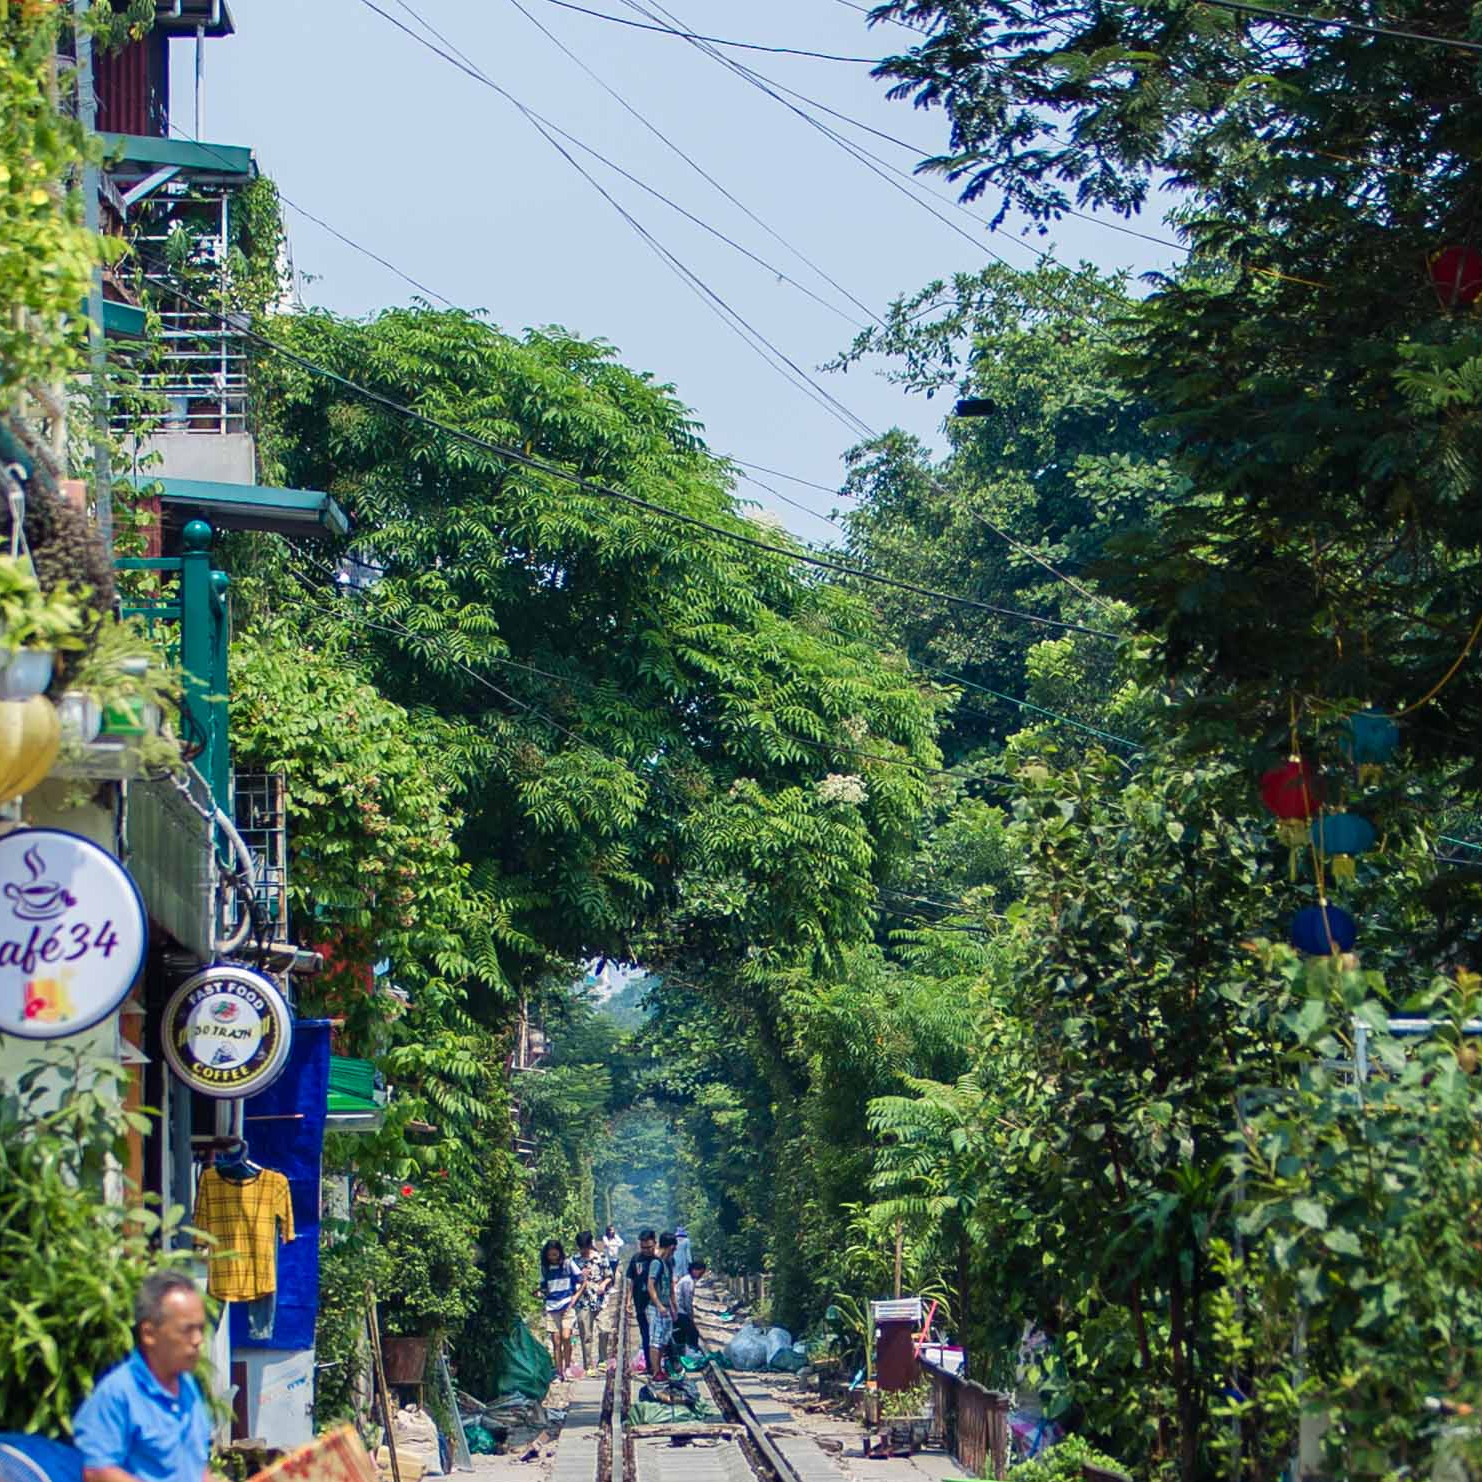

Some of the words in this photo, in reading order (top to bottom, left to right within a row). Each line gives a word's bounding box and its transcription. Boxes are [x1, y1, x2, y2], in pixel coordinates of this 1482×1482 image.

[189, 982, 224, 1005] FAST
[227, 983, 265, 1011] FOOD
[191, 1062, 251, 1081] COFFEE
